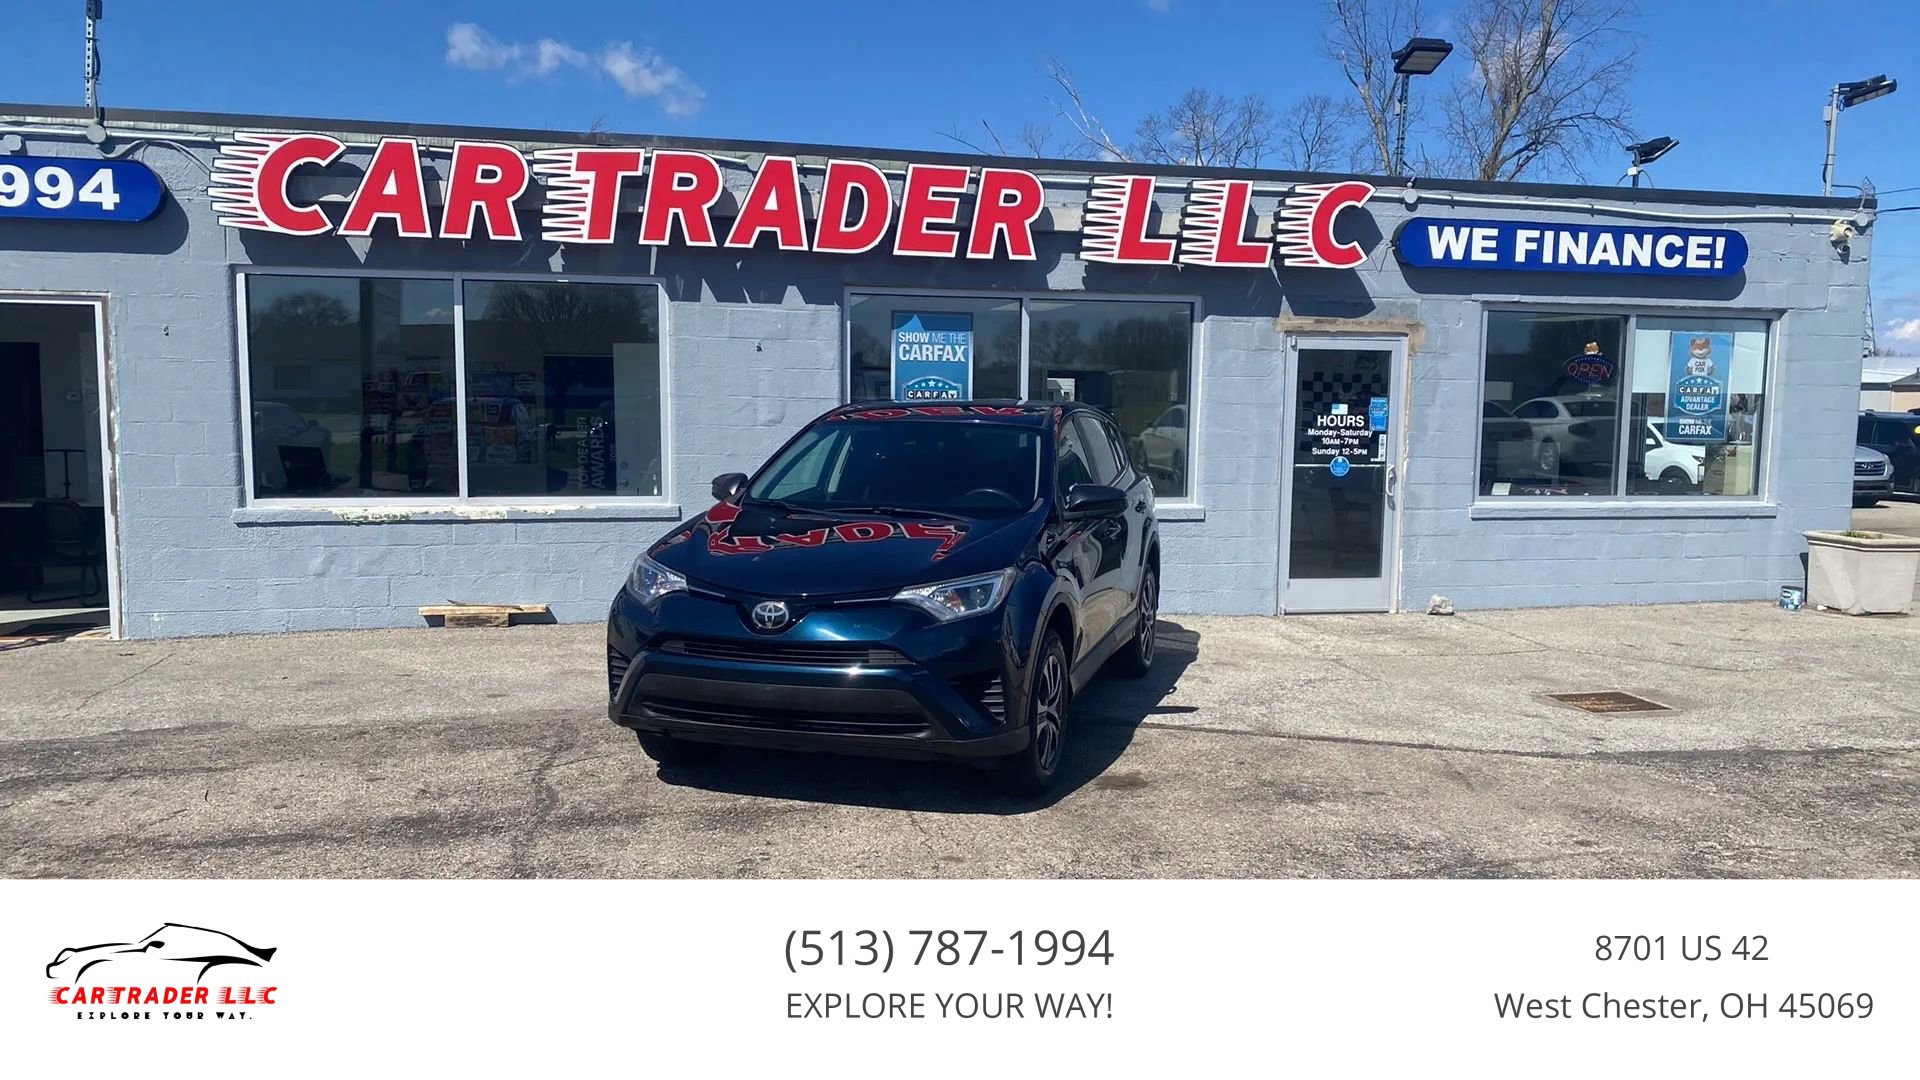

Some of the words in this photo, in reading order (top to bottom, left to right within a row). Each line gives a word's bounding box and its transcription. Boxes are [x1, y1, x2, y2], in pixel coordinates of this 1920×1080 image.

[207, 131, 529, 241] CAR
[533, 147, 1045, 260] TRADER
[1080, 175, 1377, 269] LLC
[1428, 226, 1498, 261] WE
[1516, 229, 1726, 269] FINANCE!
[898, 332, 929, 343] SHOW
[932, 333, 946, 344] ME
[949, 333, 966, 345] THE
[898, 344, 967, 362] CARFAX
[1568, 362, 1614, 379] OPEN
[1317, 415, 1365, 427] HOURS
[1307, 428, 1373, 438] Monday-Saturday
[1679, 425, 1712, 435] CARFAX
[1311, 447, 1340, 456] Sunday
